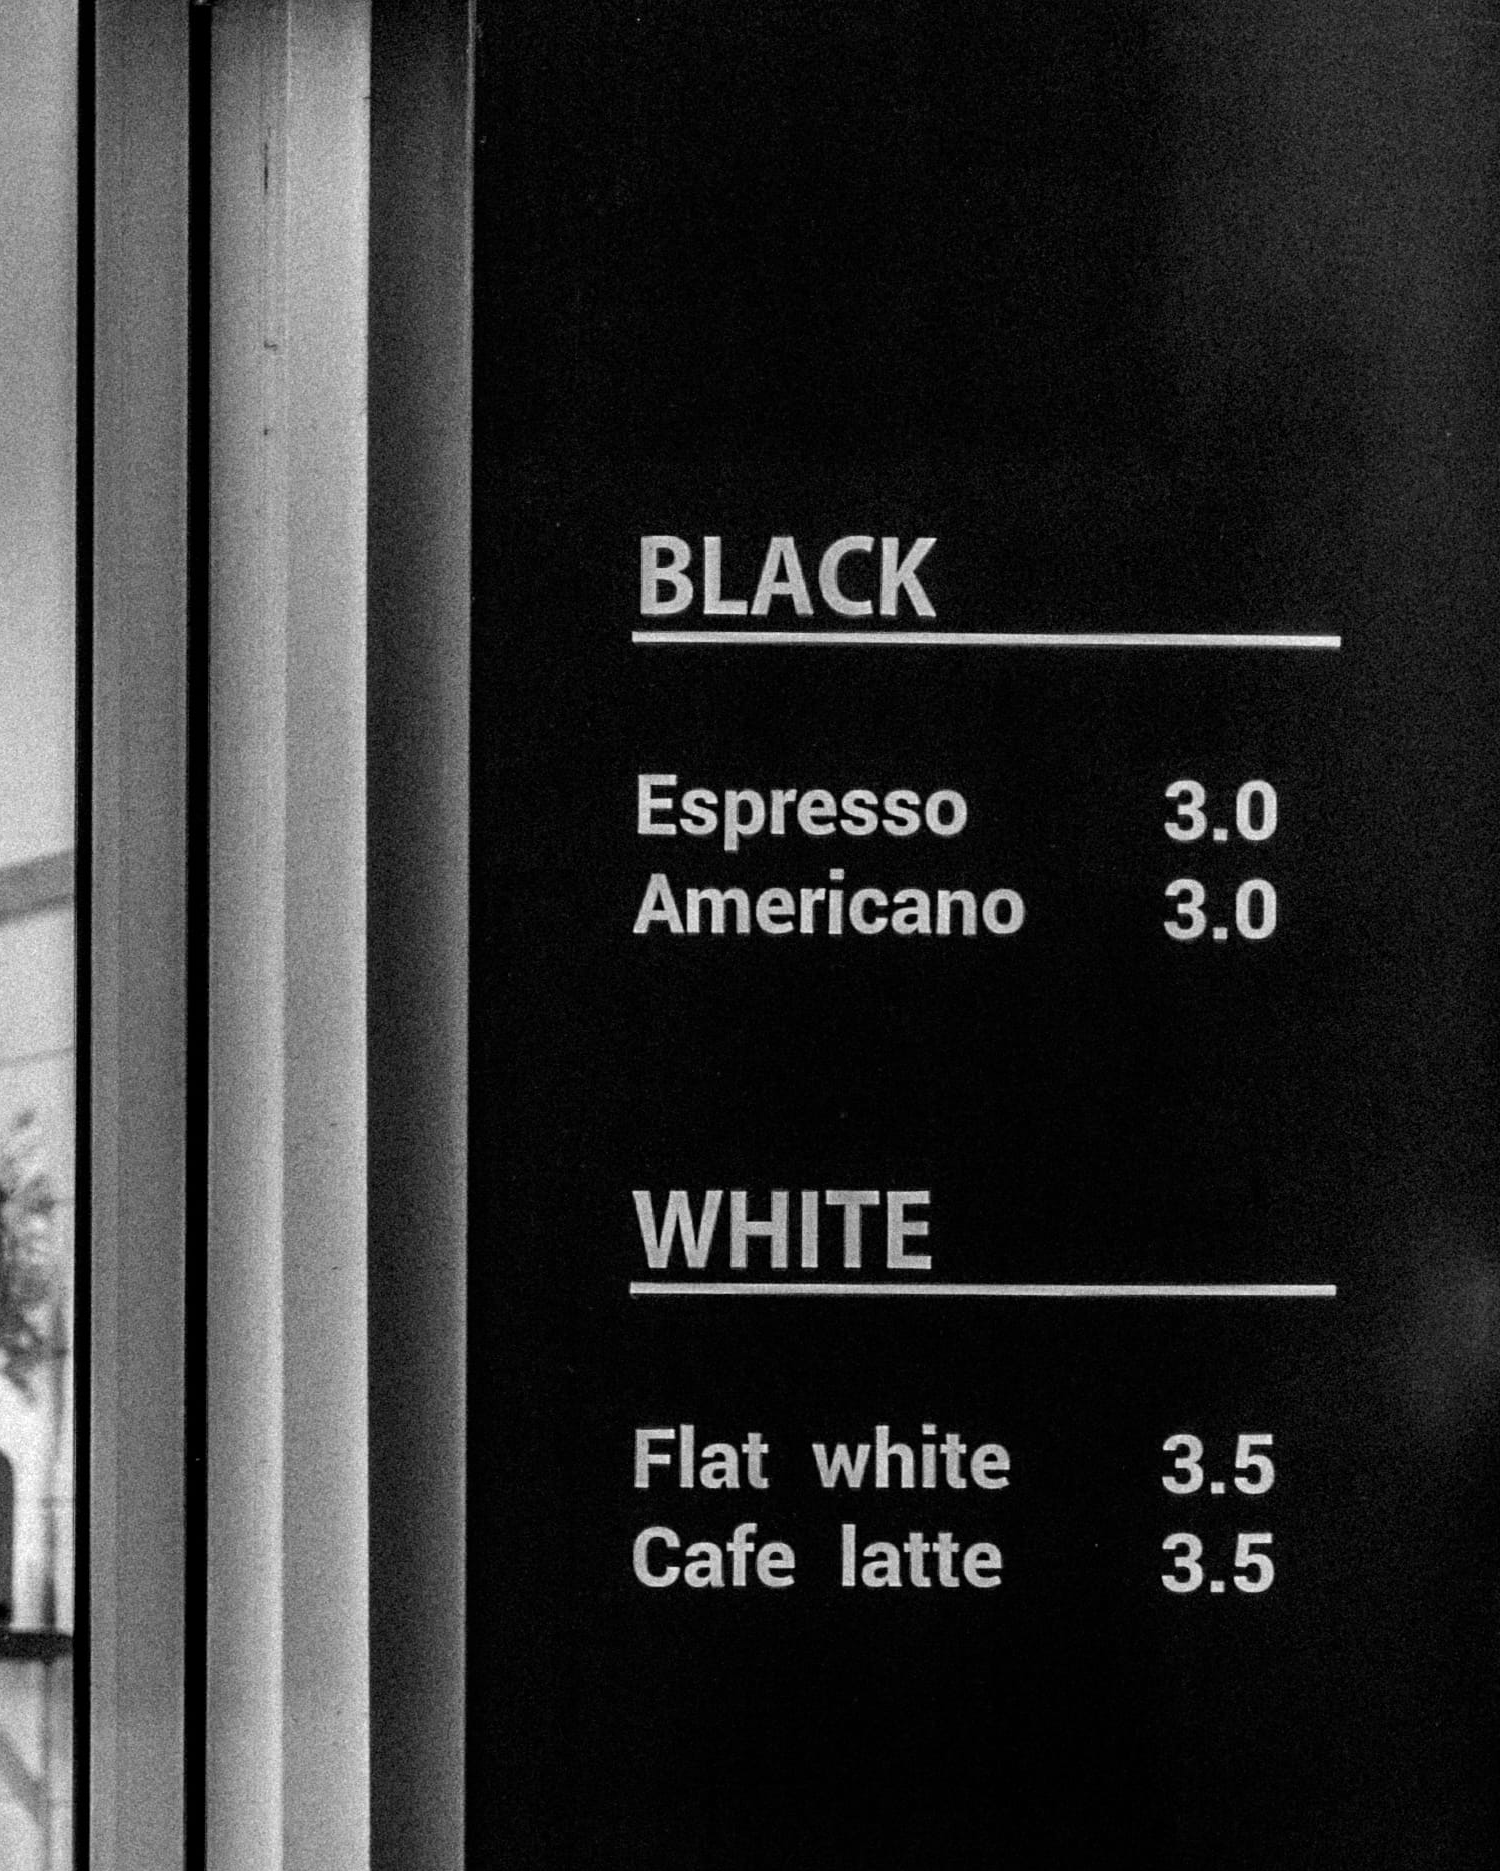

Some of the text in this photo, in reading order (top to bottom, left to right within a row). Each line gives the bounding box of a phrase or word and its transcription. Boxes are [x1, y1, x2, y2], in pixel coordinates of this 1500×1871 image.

[641, 535, 937, 617] BLACK
[638, 774, 1277, 851] Espresso 3.0
[633, 869, 1277, 940] Americano 3.0
[632, 1190, 932, 1269] WHITE
[634, 1424, 1275, 1494] Flat white 3.5
[633, 1523, 1274, 1593] Cafe latte 3.5
